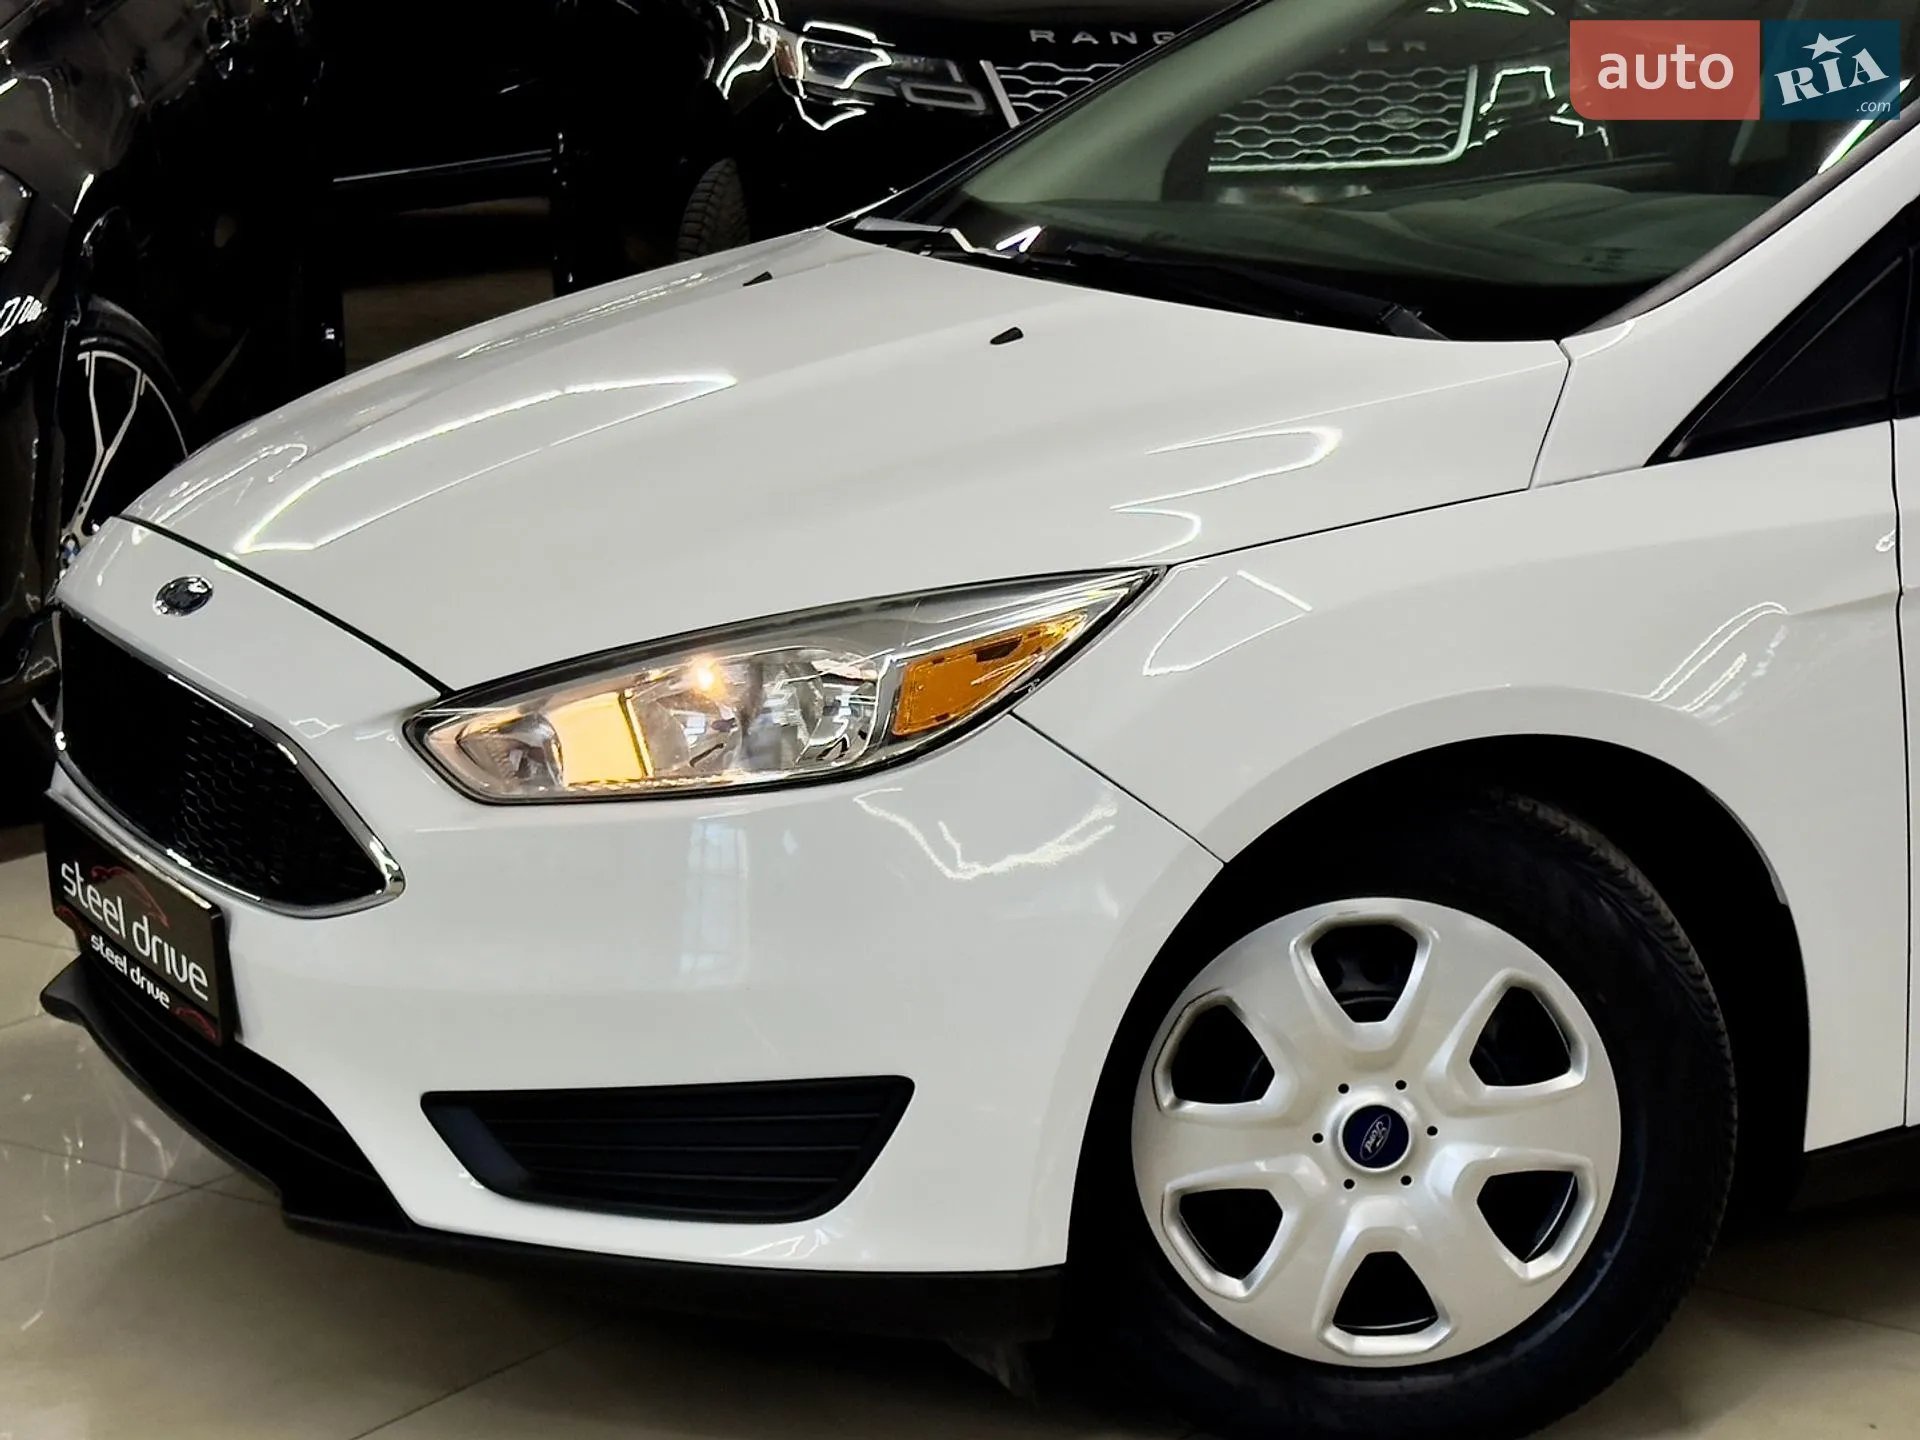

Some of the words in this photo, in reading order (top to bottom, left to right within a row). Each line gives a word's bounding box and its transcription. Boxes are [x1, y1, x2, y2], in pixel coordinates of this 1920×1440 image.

[60, 860, 127, 939] steel
[132, 914, 209, 1002] drive
[90, 935, 129, 977] steel
[130, 966, 171, 1010] drive
